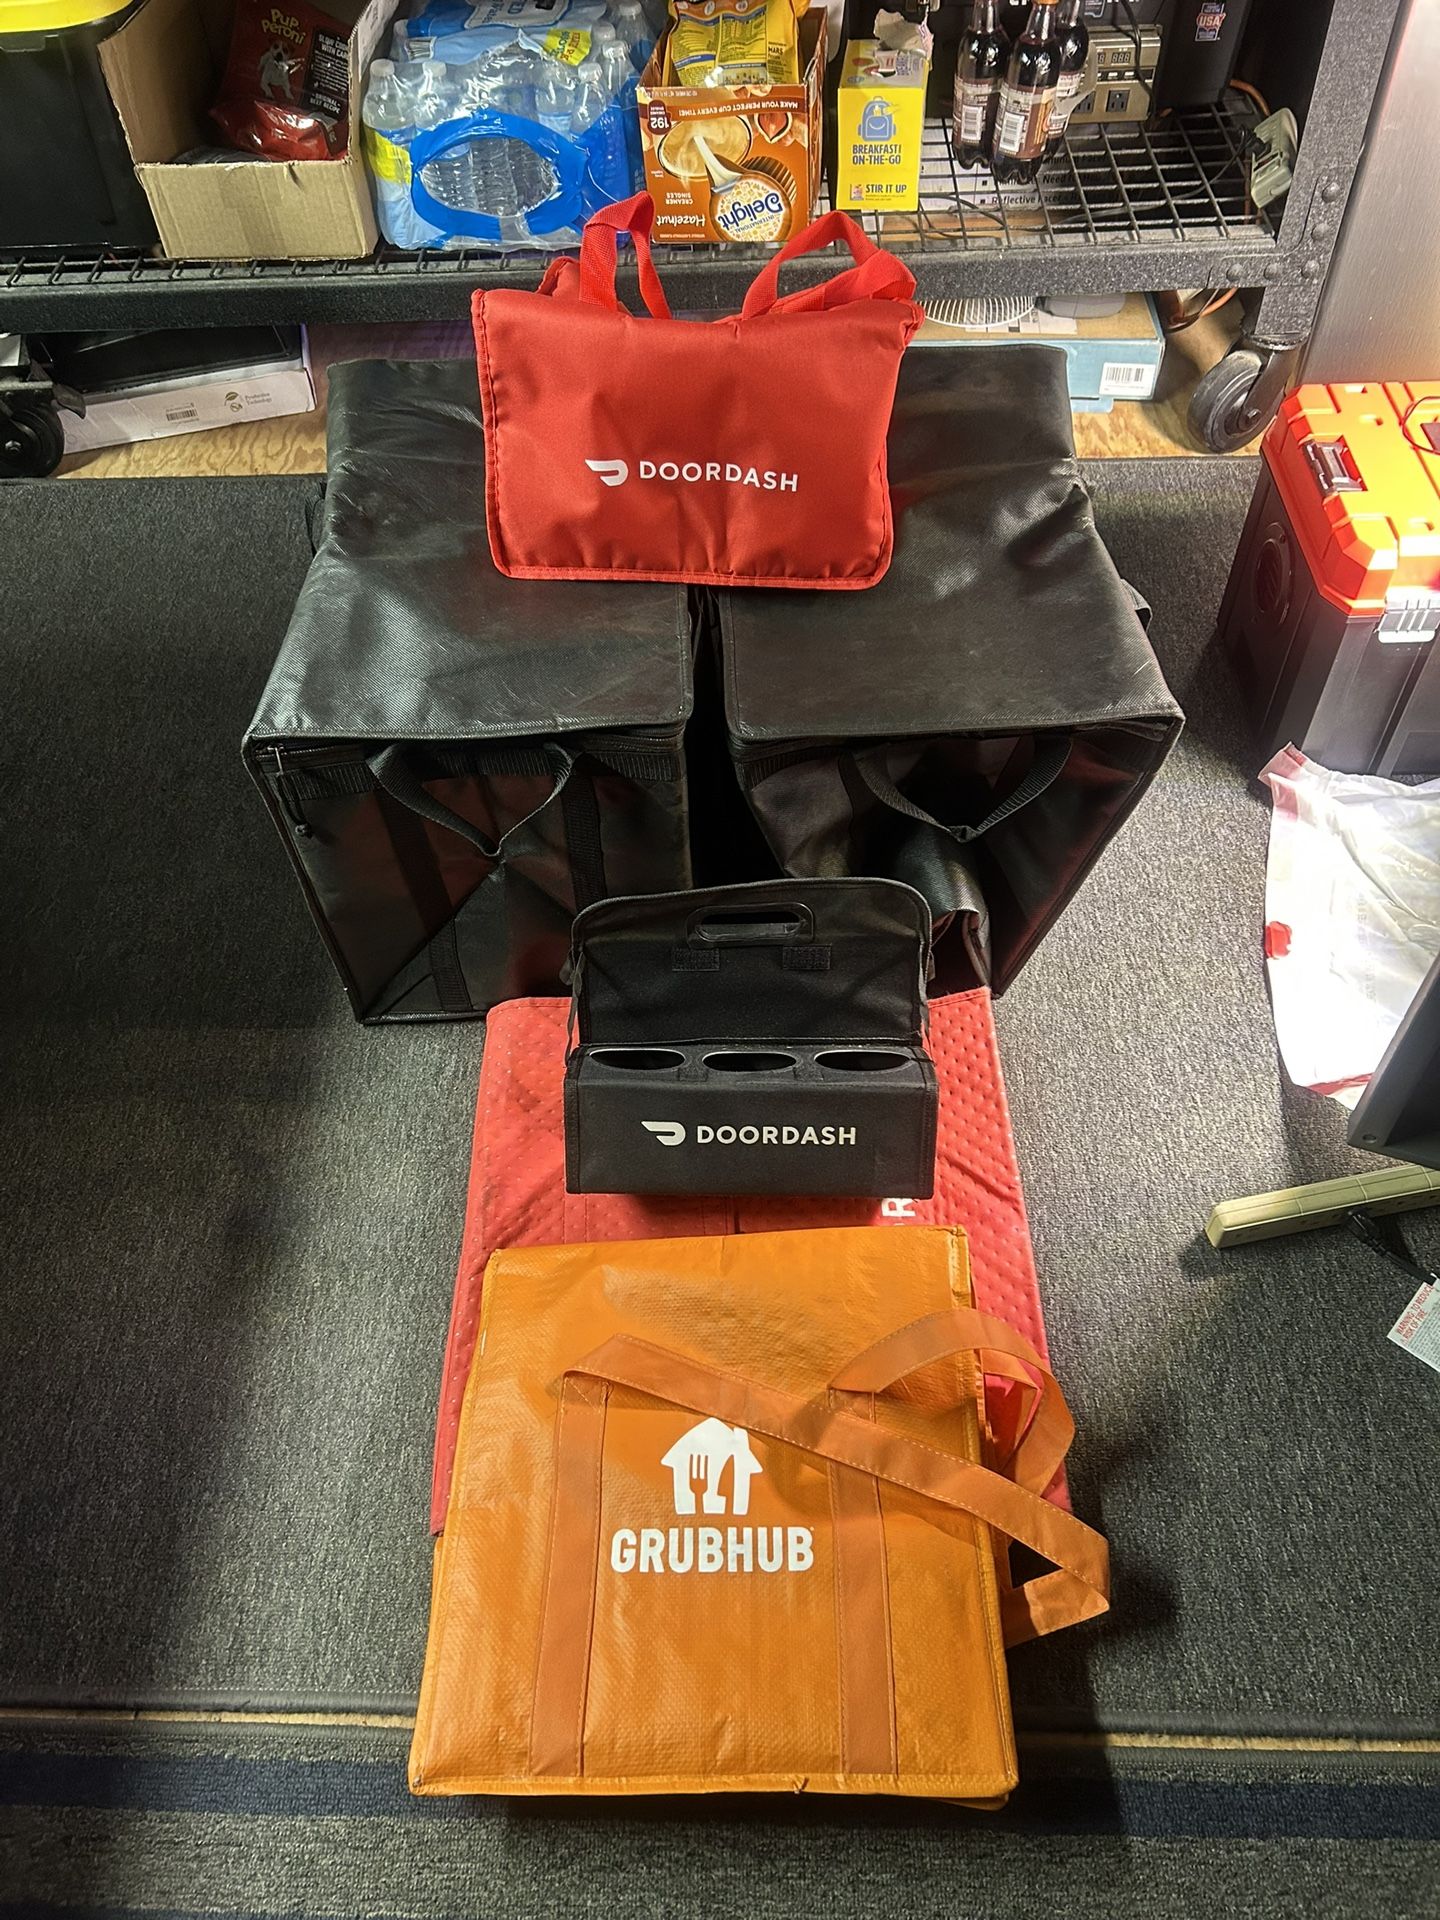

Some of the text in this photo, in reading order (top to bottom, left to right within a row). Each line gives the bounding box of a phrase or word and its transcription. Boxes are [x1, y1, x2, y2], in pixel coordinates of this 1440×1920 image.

[1199, 15, 1221, 27] USA
[697, 107, 718, 115] EVERY
[719, 105, 732, 113] CUP
[732, 102, 761, 111] PERFECT
[761, 101, 780, 109] YOUR
[780, 101, 798, 109] MAKE
[650, 117, 669, 129] 192
[852, 155, 901, 165] ON-THE-GO
[865, 184, 907, 193] STIR IT UP
[718, 193, 783, 231] Delight
[656, 213, 706, 227] Hazelnut
[735, 214, 775, 232] INTERNATIONAL
[639, 460, 799, 492] DOORDASH
[697, 1125, 857, 1145] DOORDASH
[610, 1526, 814, 1574] GRUBHUB
